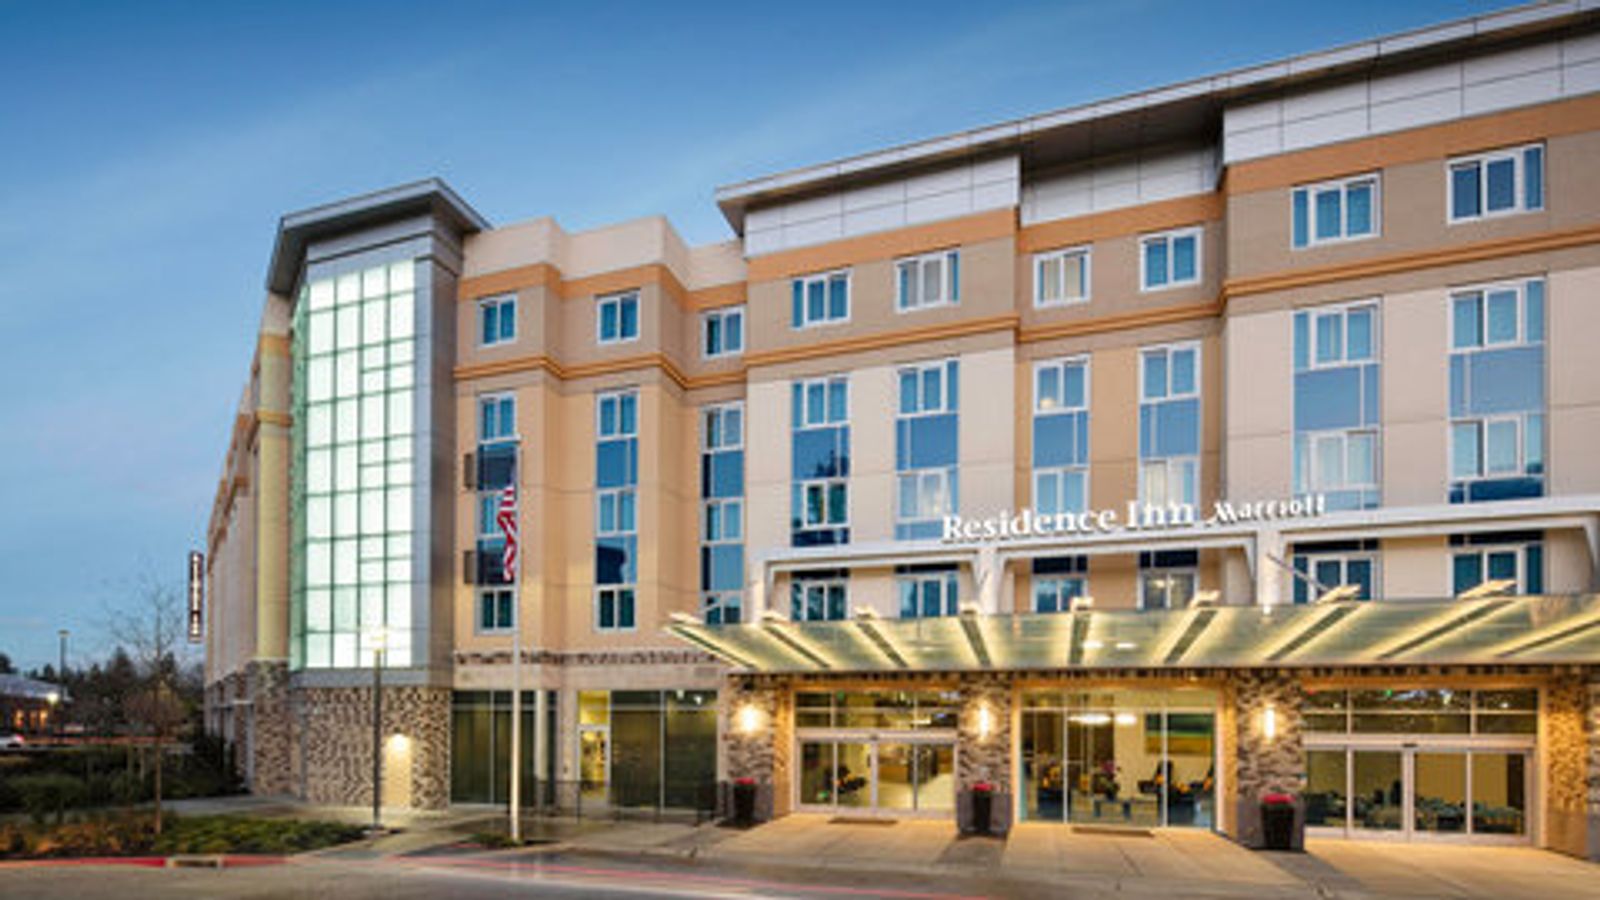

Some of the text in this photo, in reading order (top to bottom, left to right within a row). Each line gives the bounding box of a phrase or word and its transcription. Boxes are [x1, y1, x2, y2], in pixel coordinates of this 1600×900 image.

[942, 493, 1325, 541] Residence Inn Marriott
